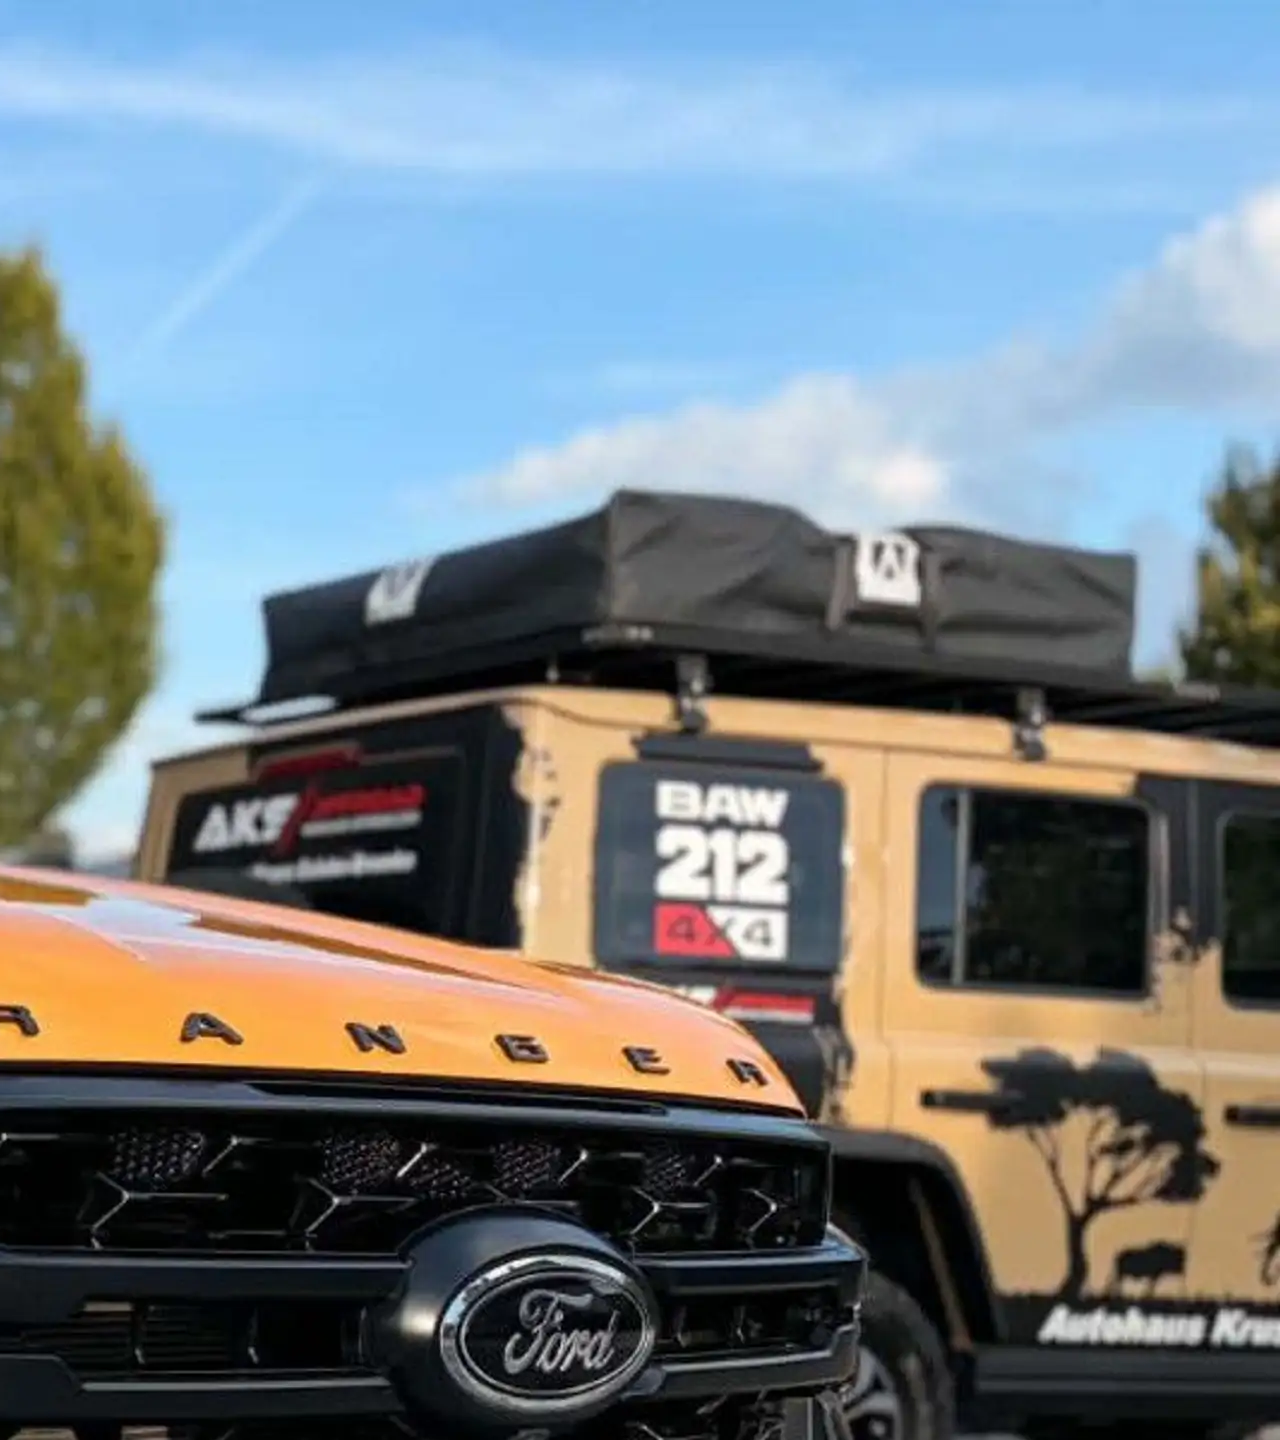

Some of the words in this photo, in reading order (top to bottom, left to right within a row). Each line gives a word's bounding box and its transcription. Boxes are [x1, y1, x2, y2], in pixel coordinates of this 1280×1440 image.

[656, 781, 789, 828] BAW
[656, 824, 790, 906] 212
[503, 1288, 622, 1376] Ford
[1037, 1303, 1207, 1347] Autohaus
